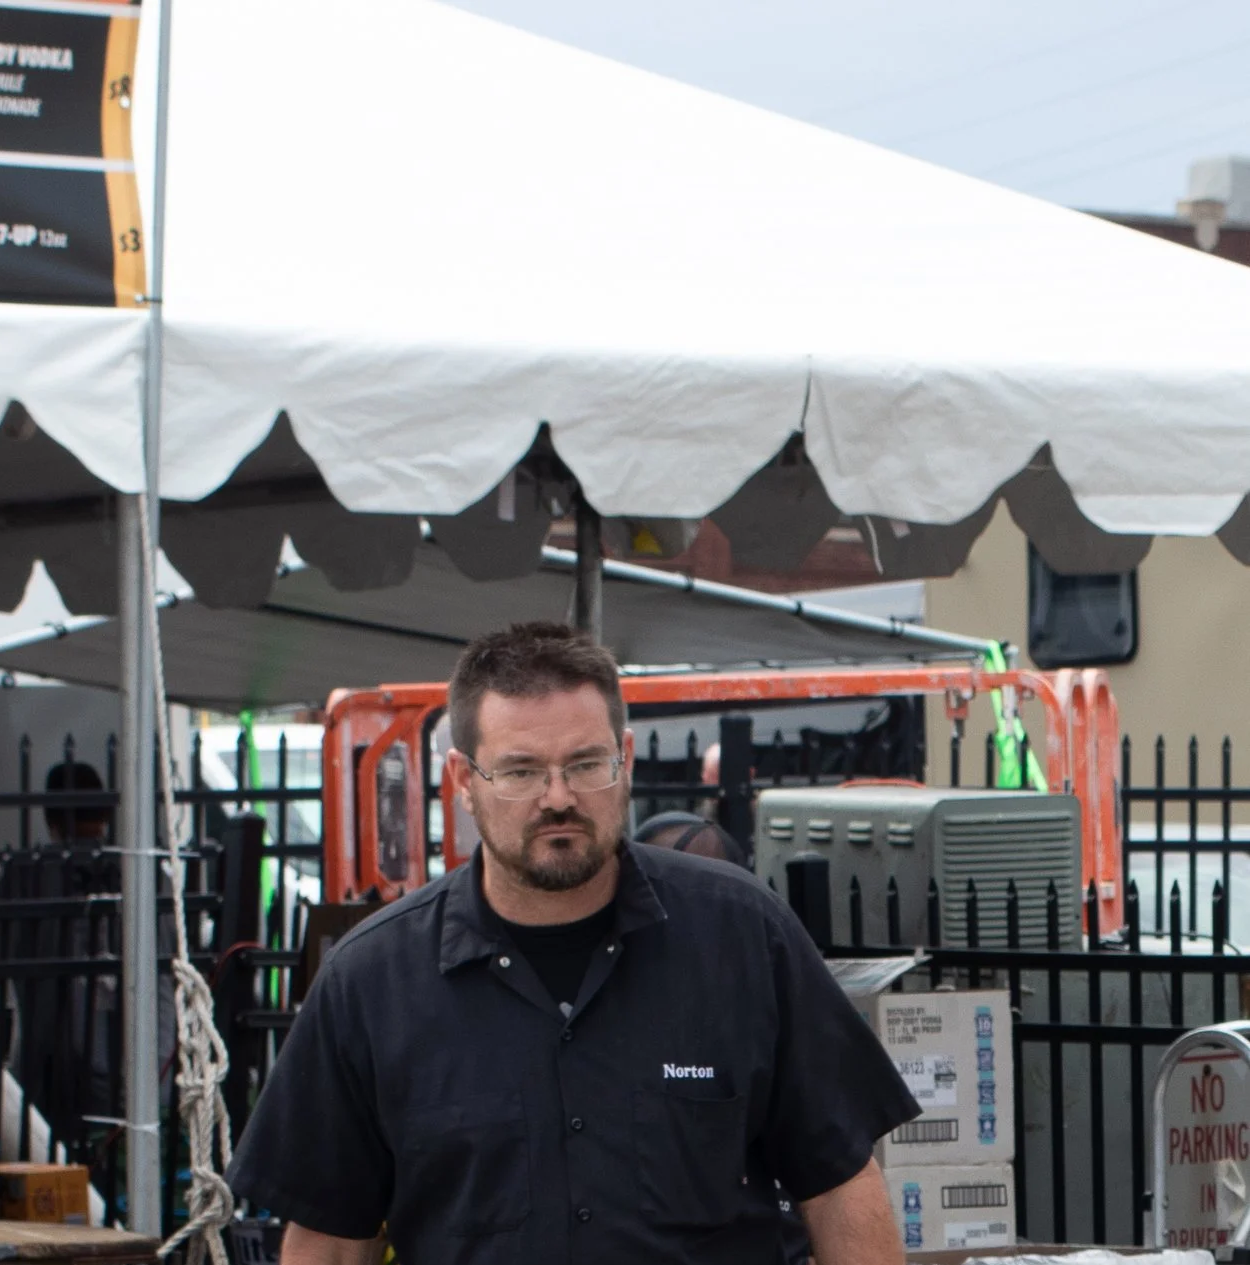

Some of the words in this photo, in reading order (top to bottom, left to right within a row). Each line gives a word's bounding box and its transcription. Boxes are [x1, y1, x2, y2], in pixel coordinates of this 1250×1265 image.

[17, 43, 74, 70] VODKA
[119, 227, 141, 253] $3
[662, 1063, 715, 1079] Norton
[1191, 1073, 1225, 1115] NO
[1168, 1122, 1250, 1166] PARKING
[1200, 1182, 1218, 1214] IN
